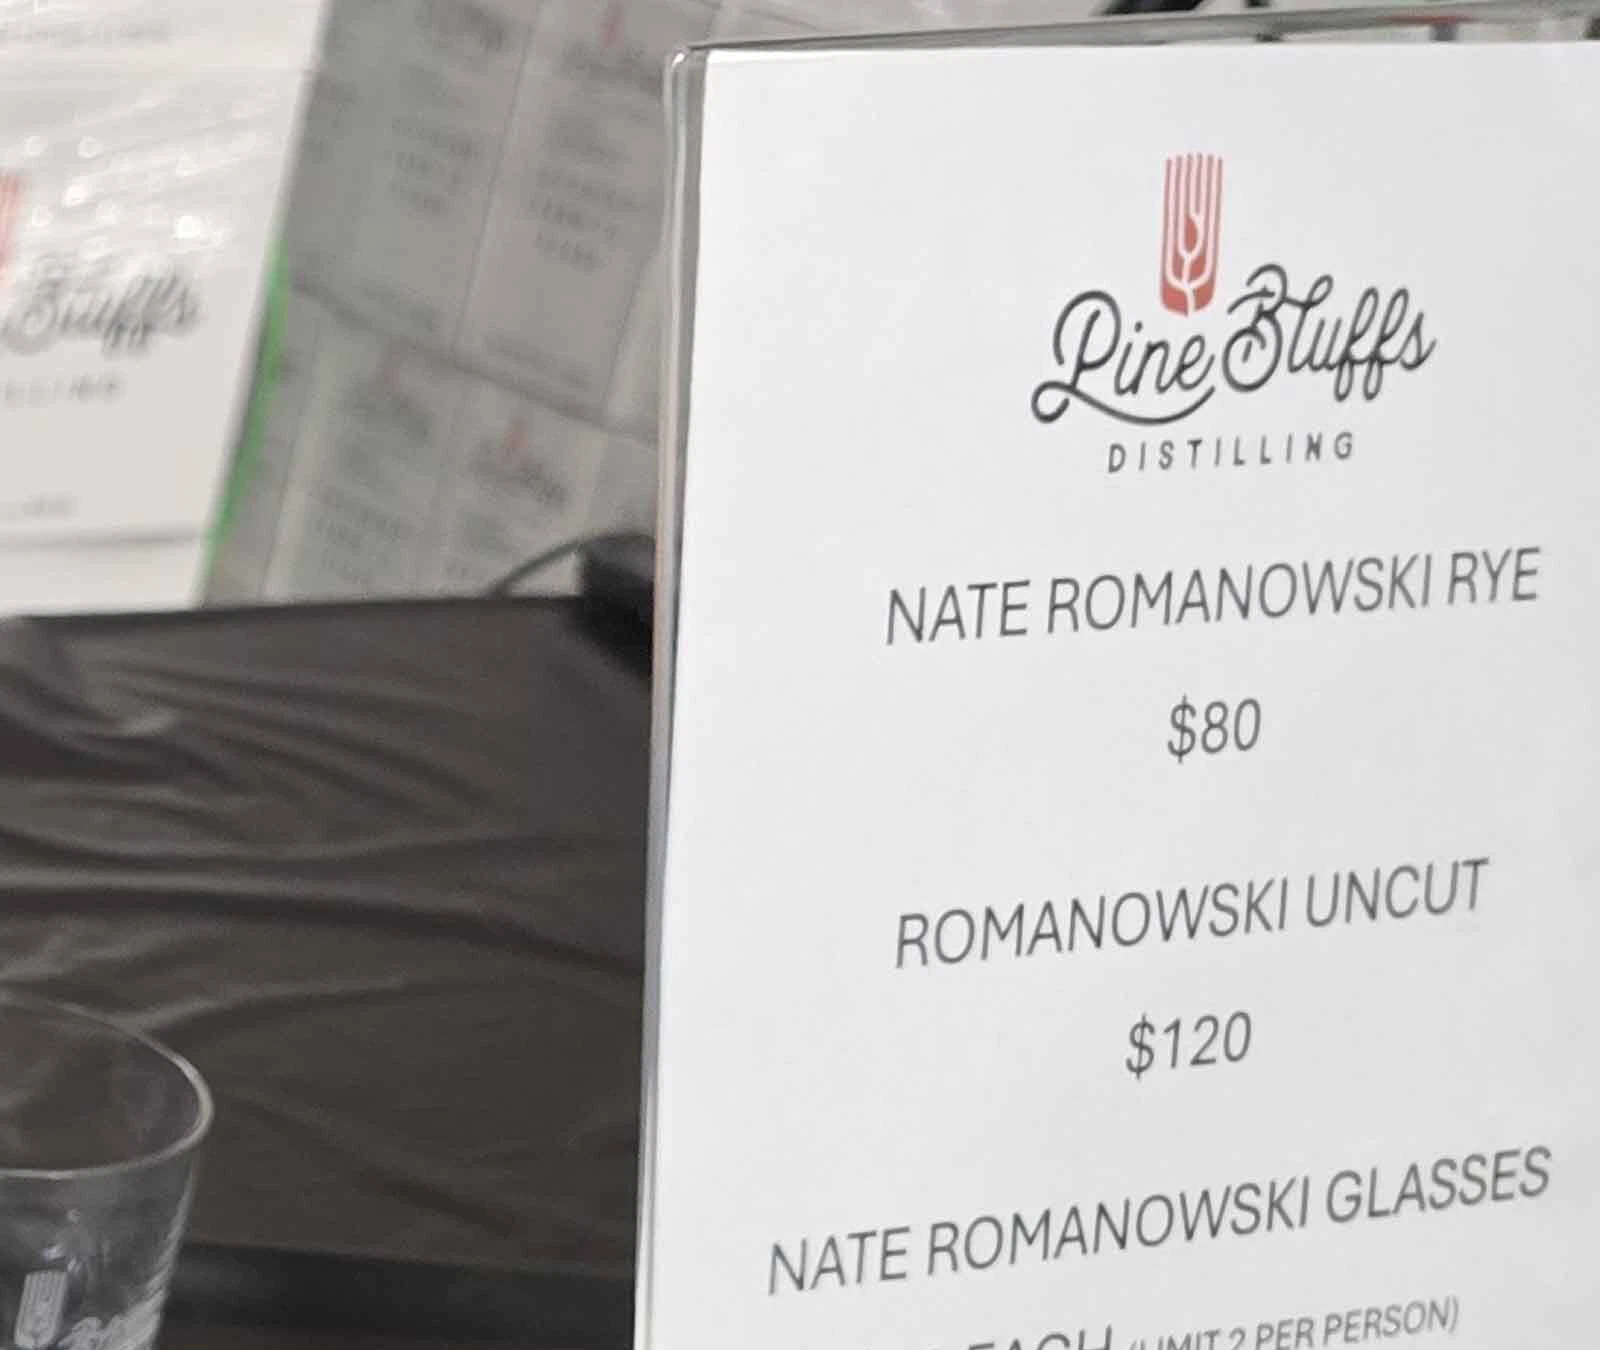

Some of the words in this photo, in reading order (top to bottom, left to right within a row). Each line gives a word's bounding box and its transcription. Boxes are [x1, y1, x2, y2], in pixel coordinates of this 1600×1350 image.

[1030, 290, 1216, 426] Pine
[1220, 264, 1437, 403] Bluffs
[1108, 432, 1356, 474] DISTILLING
[886, 581, 1029, 645] NATE
[1048, 554, 1433, 634] ROMANOWSKI
[1447, 547, 1541, 606] RYE
[1167, 696, 1262, 763] $80
[895, 876, 1288, 968] ROMANOWSKI
[1306, 857, 1490, 929] UNCUT
[1125, 1011, 1252, 1080] $120
[768, 1226, 910, 1296] NATE
[927, 1176, 1310, 1274] ROMANOWSKI
[1325, 1145, 1552, 1225] GLASSES
[1322, 1295, 1460, 1345] PERSON)
